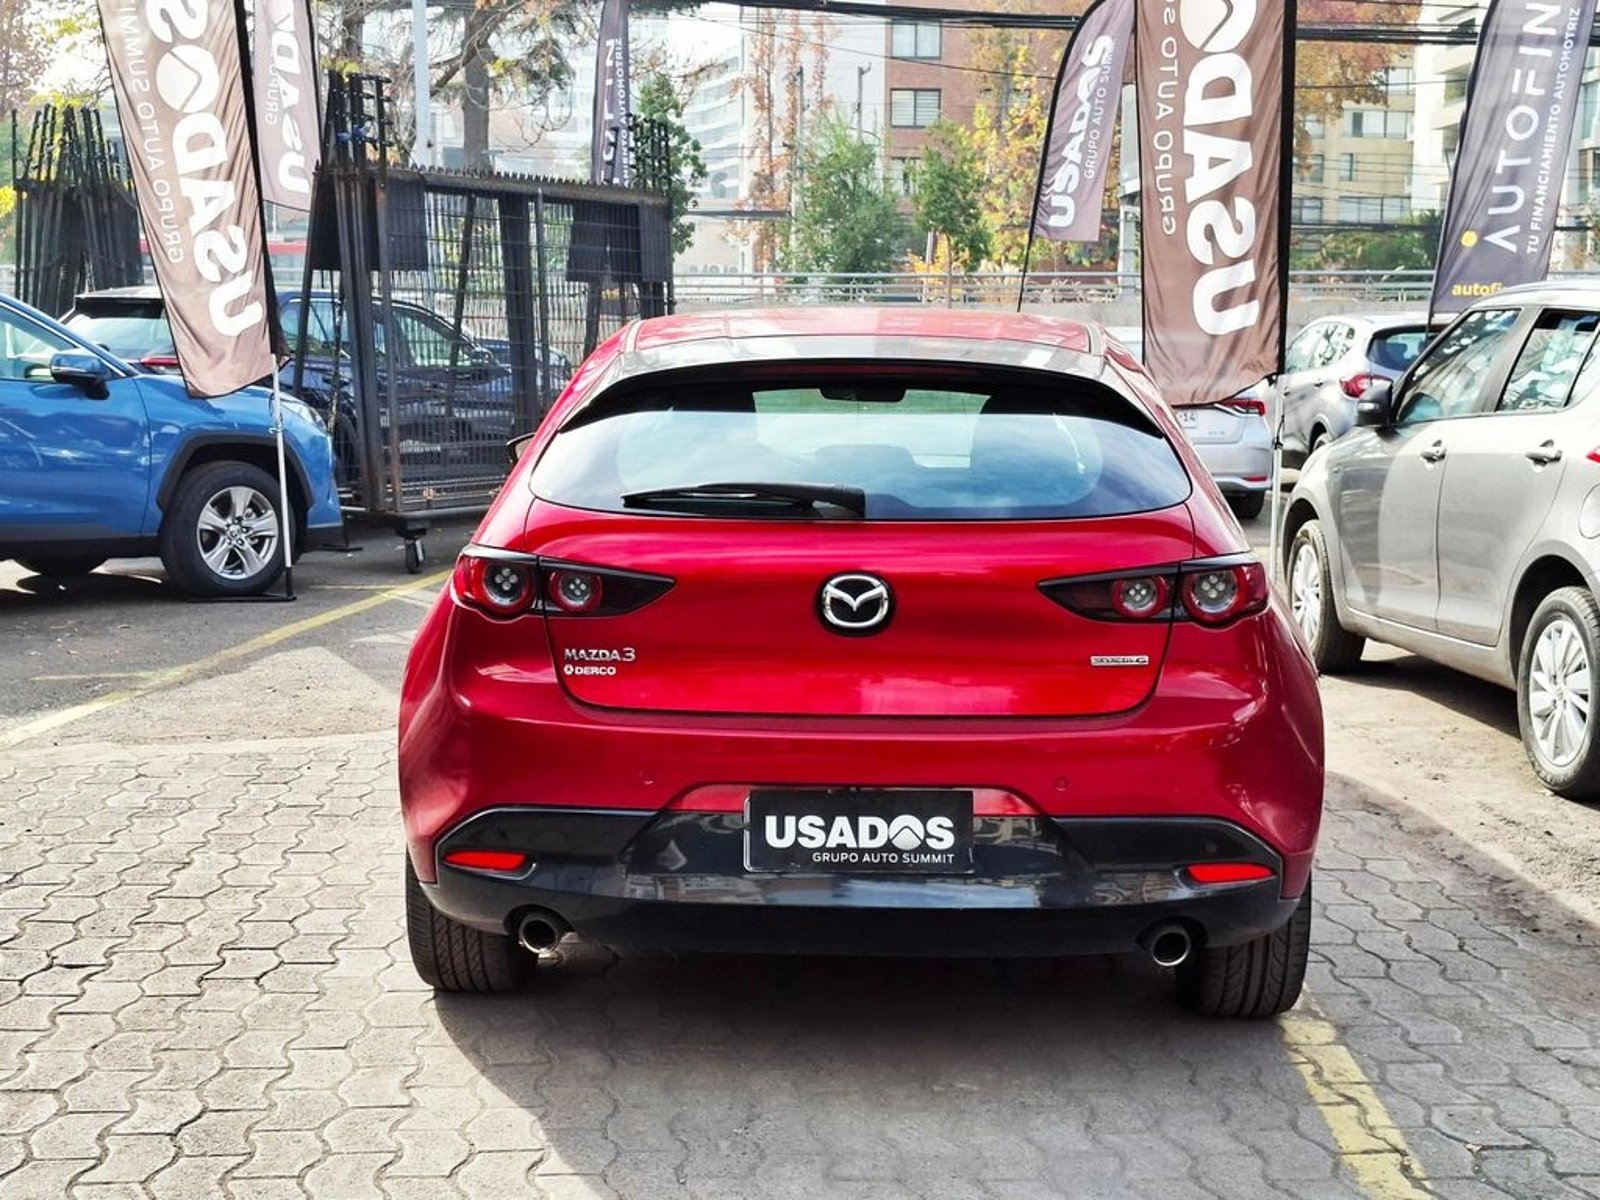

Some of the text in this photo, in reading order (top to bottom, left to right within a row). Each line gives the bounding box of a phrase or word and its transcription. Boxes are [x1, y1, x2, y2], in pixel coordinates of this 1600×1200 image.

[1048, 35, 1115, 227] USADOS
[1084, 129, 1101, 179] GRUPO
[1094, 87, 1107, 128] AUTO
[1483, 2, 1561, 252] AUTOFIN
[1526, 7, 1580, 254] TU FINANCIAMIENTO AUTOMOTRIZ
[574, 666, 617, 676] DERCO
[765, 814, 955, 850] USADOS
[812, 852, 955, 864] GRUPO AUTO SUMMIT
